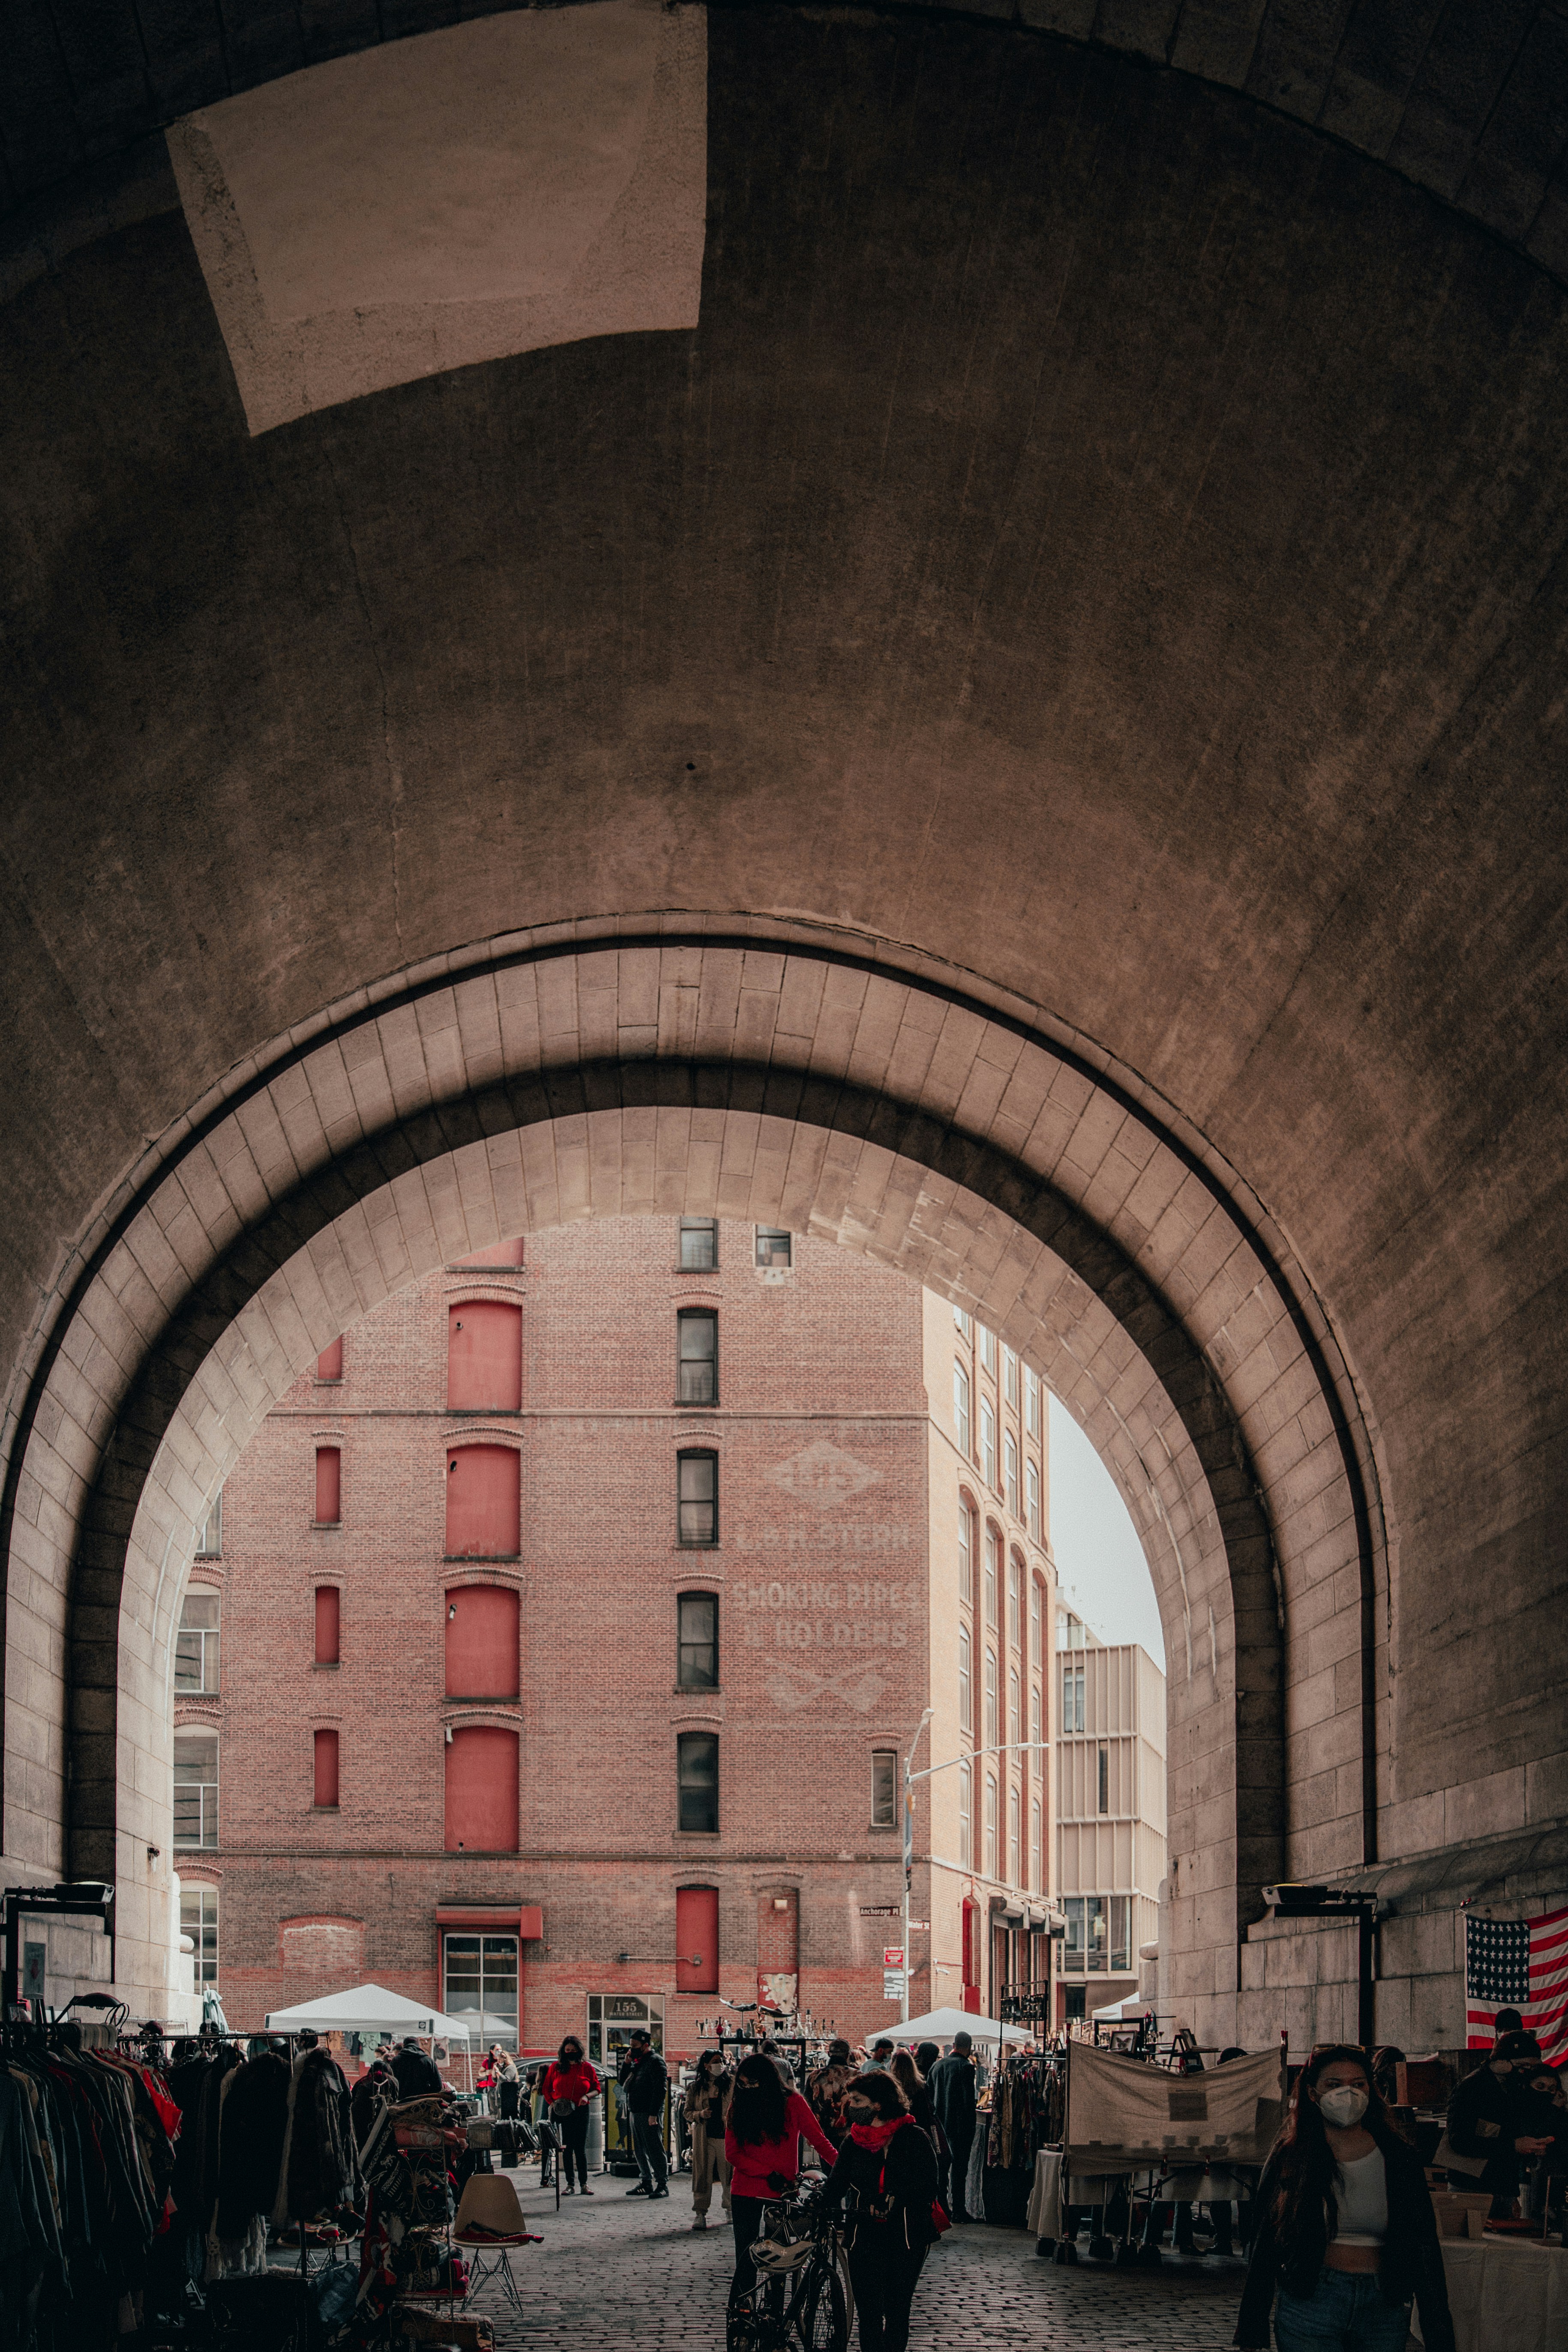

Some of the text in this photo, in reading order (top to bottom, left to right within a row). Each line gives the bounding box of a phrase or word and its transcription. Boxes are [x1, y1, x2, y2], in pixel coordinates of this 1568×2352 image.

[818, 1523, 910, 1551] STERN
[732, 1581, 920, 1610] SMOKING PIPES
[775, 1621, 908, 1649] HOLDERS
[860, 1908, 891, 1916] Anchorage
[616, 2002, 637, 2012] 155
